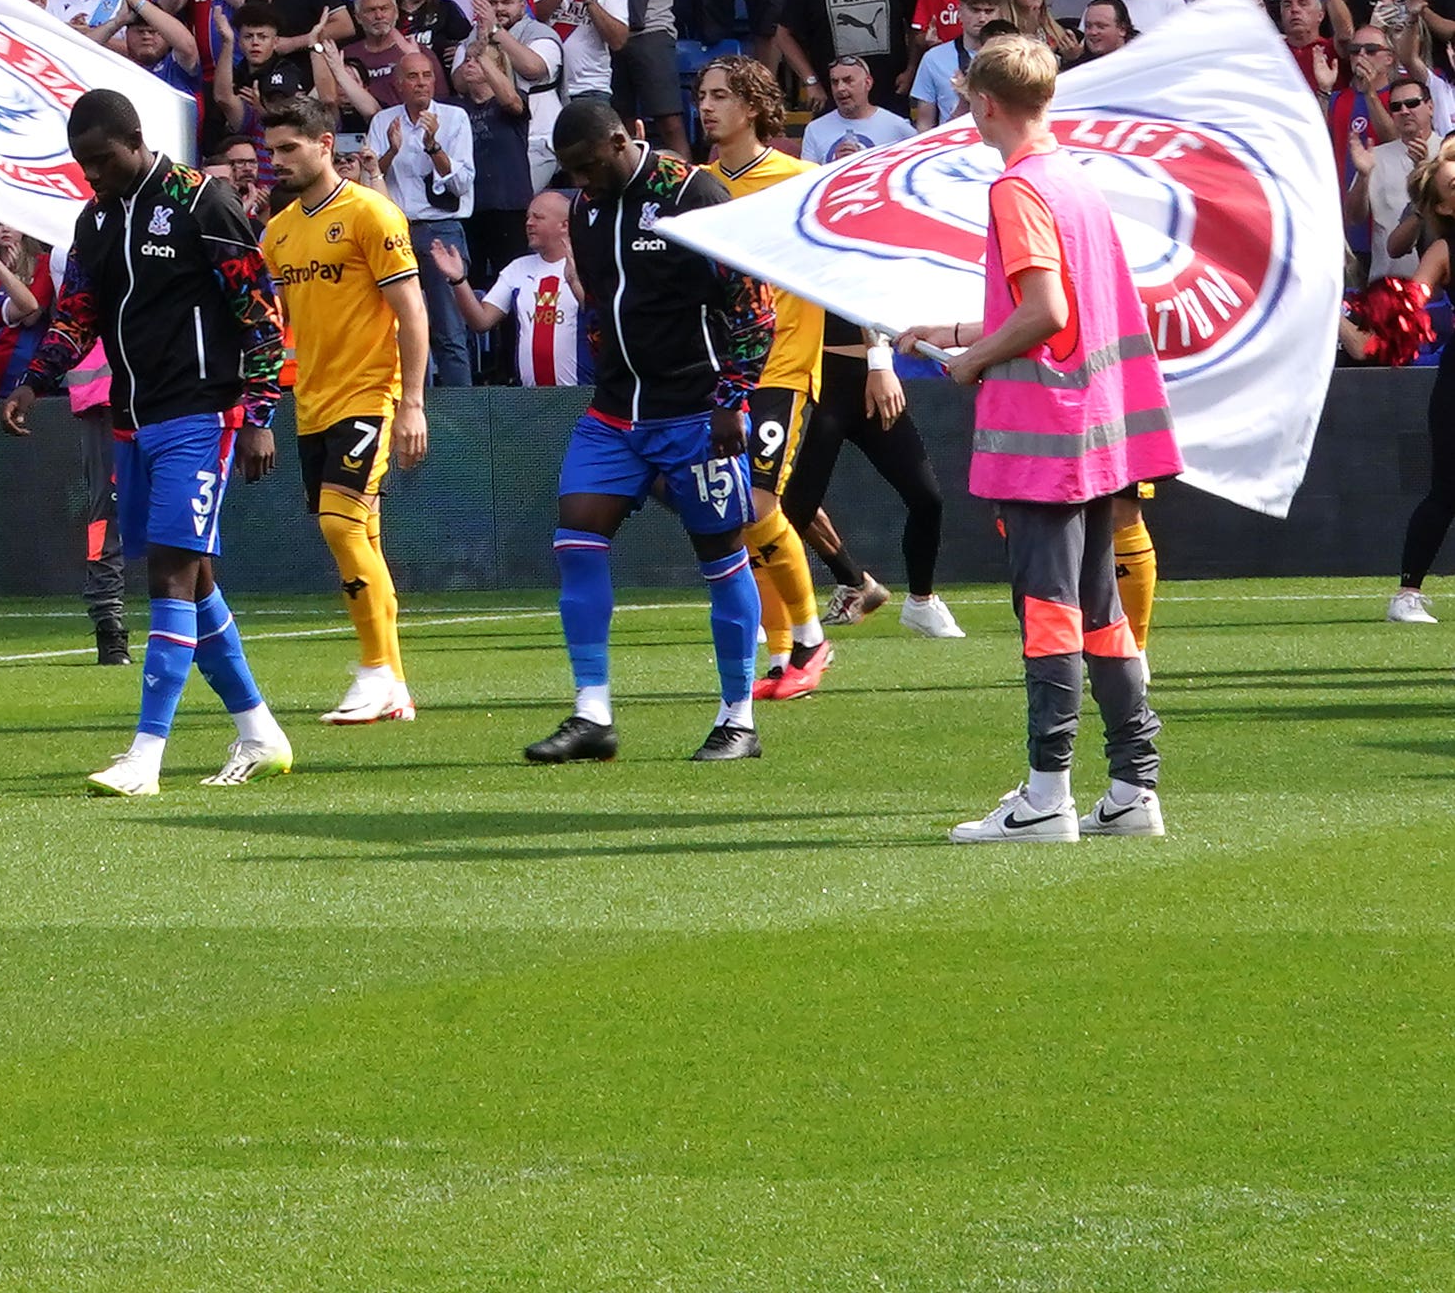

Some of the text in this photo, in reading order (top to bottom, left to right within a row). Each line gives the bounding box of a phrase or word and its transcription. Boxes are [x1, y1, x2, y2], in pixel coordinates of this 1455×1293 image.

[940, 3, 959, 25] cin
[1071, 118, 1205, 164] LIFE
[141, 240, 175, 259] cinch
[631, 237, 667, 252] cinch
[527, 310, 564, 323] W88
[349, 421, 377, 458] 7
[758, 420, 785, 456] 9
[192, 471, 217, 515] 3
[690, 457, 734, 502] 15
